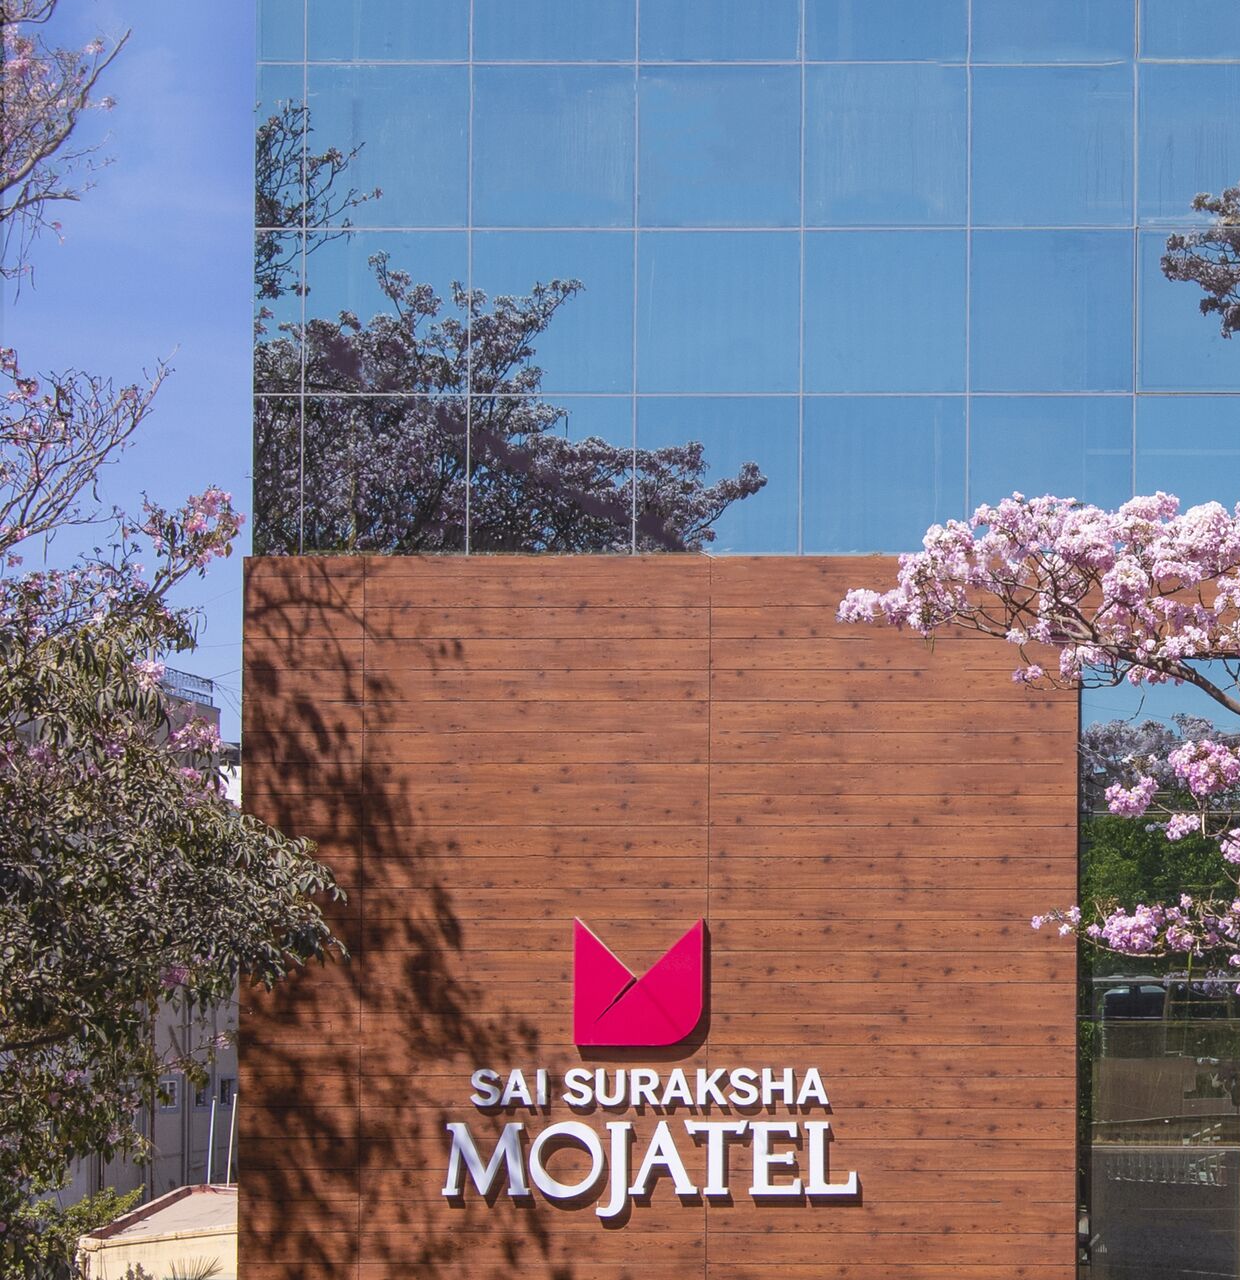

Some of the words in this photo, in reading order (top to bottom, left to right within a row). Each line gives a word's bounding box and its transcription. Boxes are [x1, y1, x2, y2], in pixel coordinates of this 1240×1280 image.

[470, 1068, 548, 1106] SAI
[562, 1067, 830, 1106] SURAKSHA
[441, 1120, 858, 1218] MOJATEL
